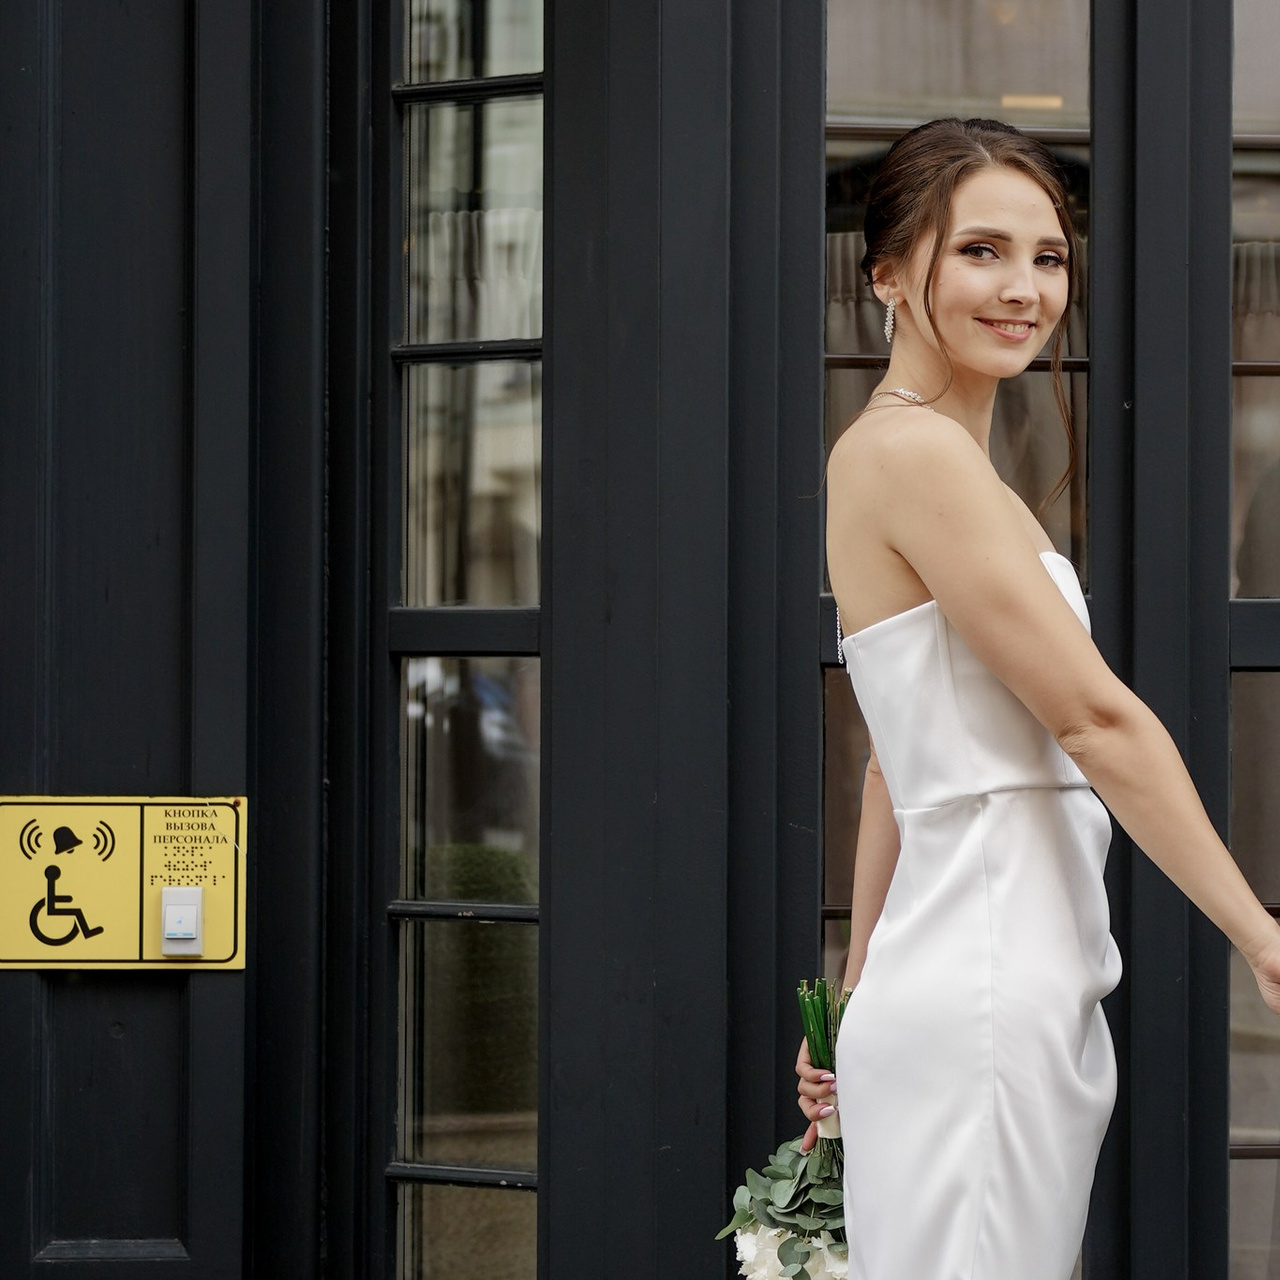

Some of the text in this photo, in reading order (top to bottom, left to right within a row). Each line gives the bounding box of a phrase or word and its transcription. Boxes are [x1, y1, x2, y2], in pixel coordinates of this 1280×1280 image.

[164, 809, 218, 818] КНОПКА
[166, 822, 216, 831] ВЫЗОВА
[153, 835, 228, 844] ПЕРСОНАЛА
